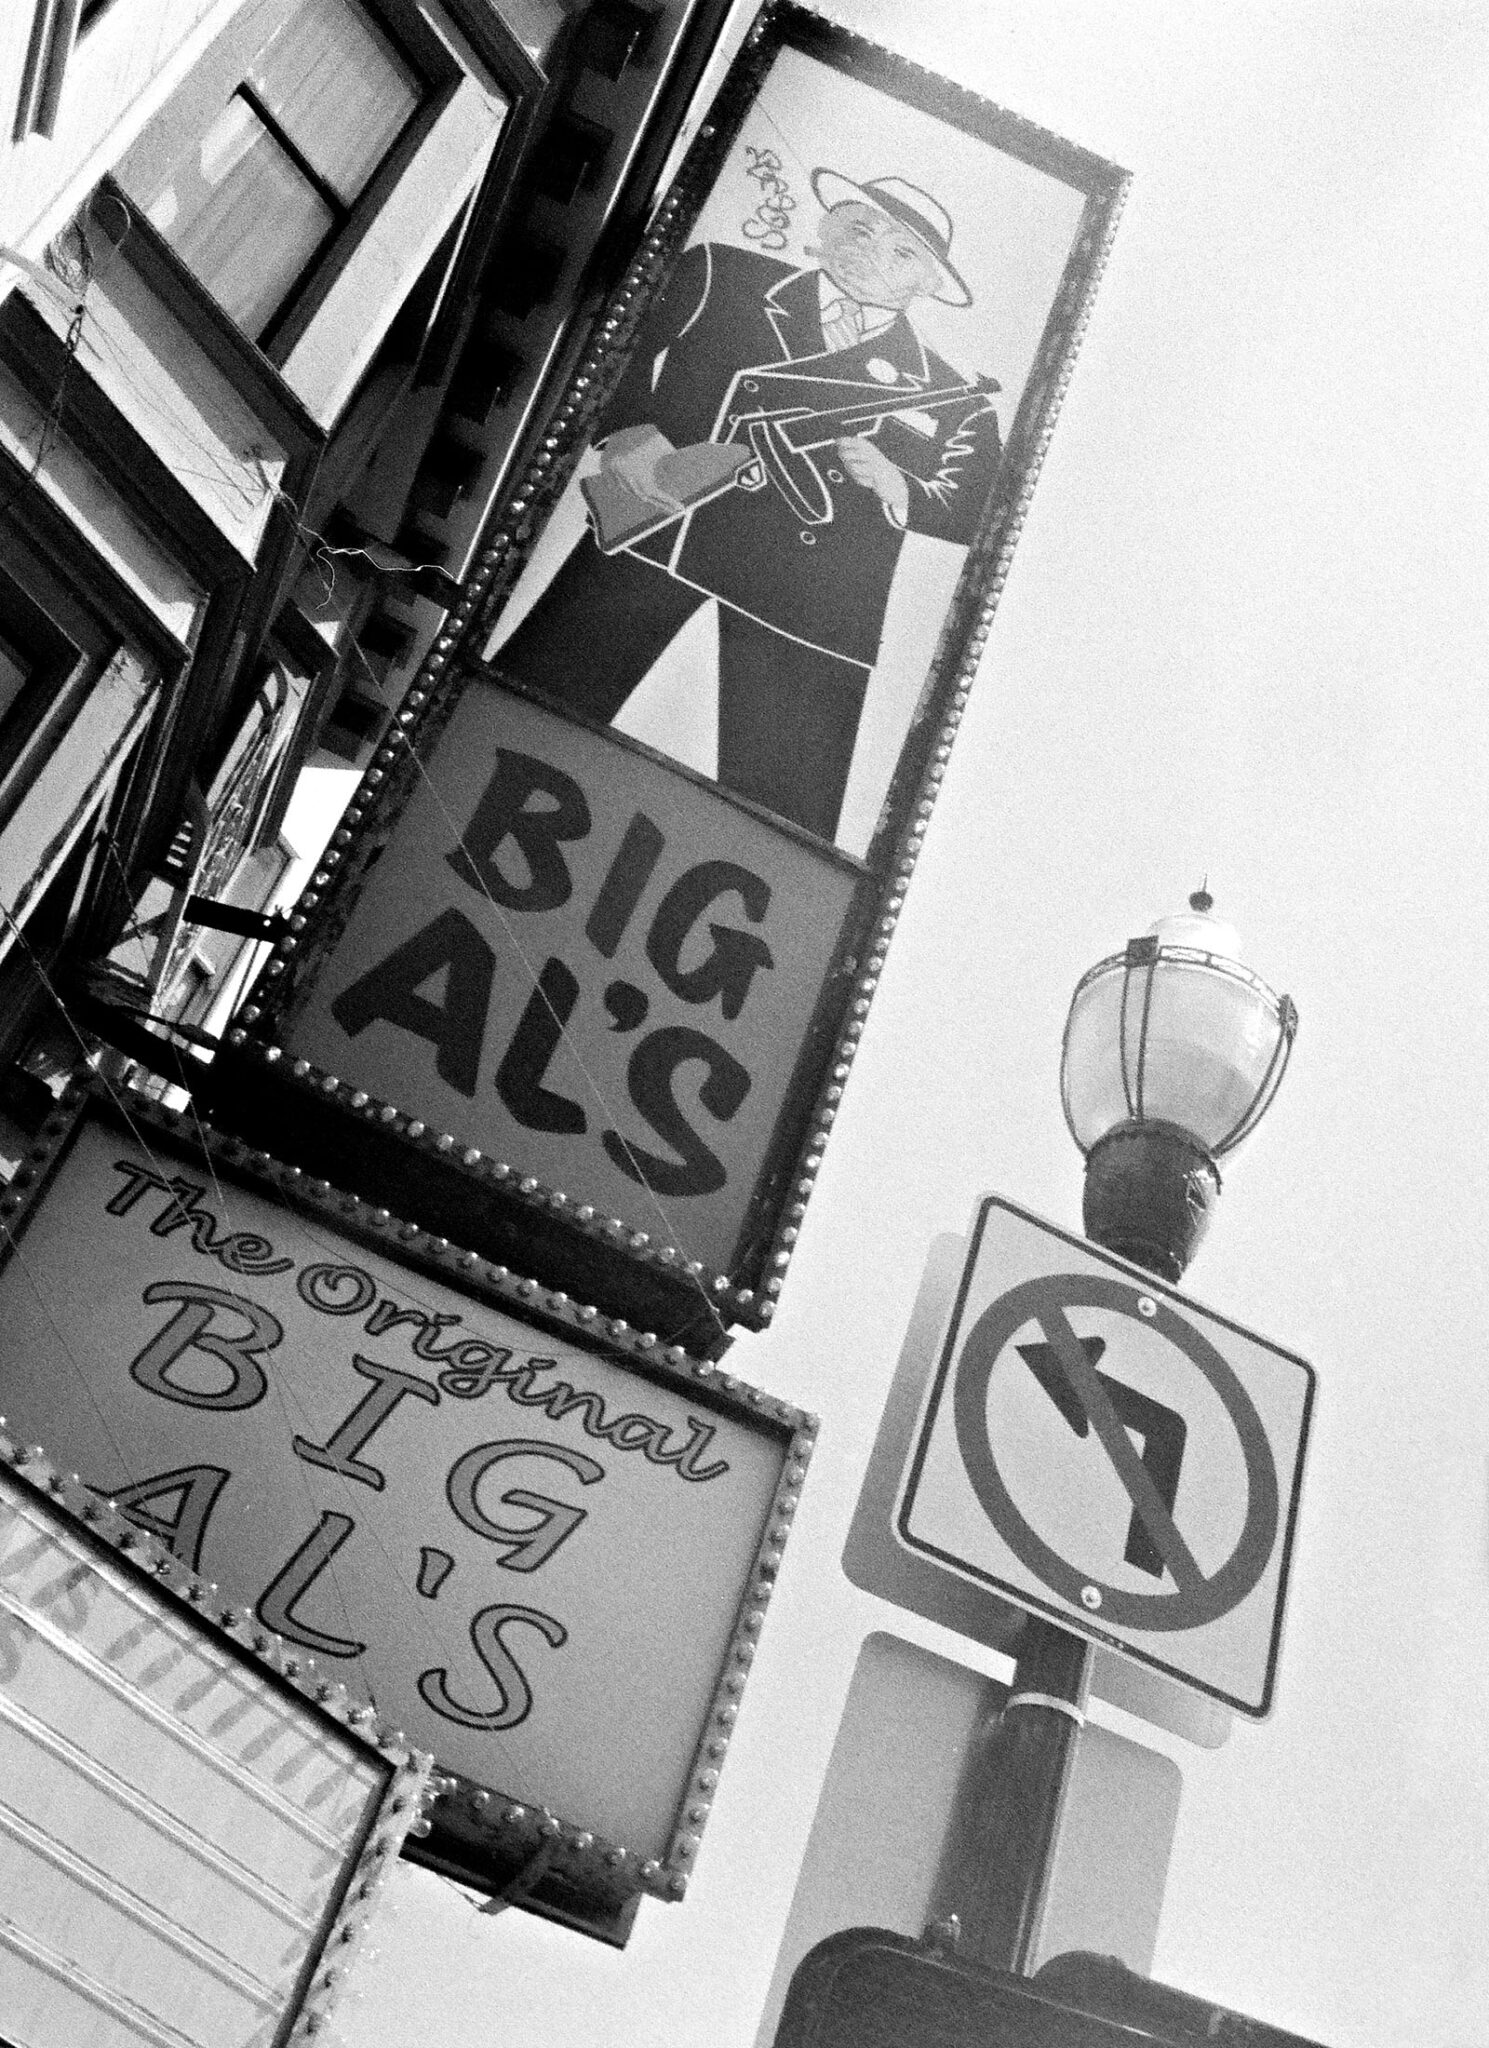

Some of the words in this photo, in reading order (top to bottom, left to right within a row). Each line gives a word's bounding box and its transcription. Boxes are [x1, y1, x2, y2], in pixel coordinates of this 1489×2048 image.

[446, 748, 774, 1020] BIG
[331, 908, 752, 1197] AL'S
[106, 1160, 294, 1275] The
[297, 1263, 729, 1481] Original
[130, 1281, 605, 1573] BIG
[86, 1464, 568, 1730] AL'S
